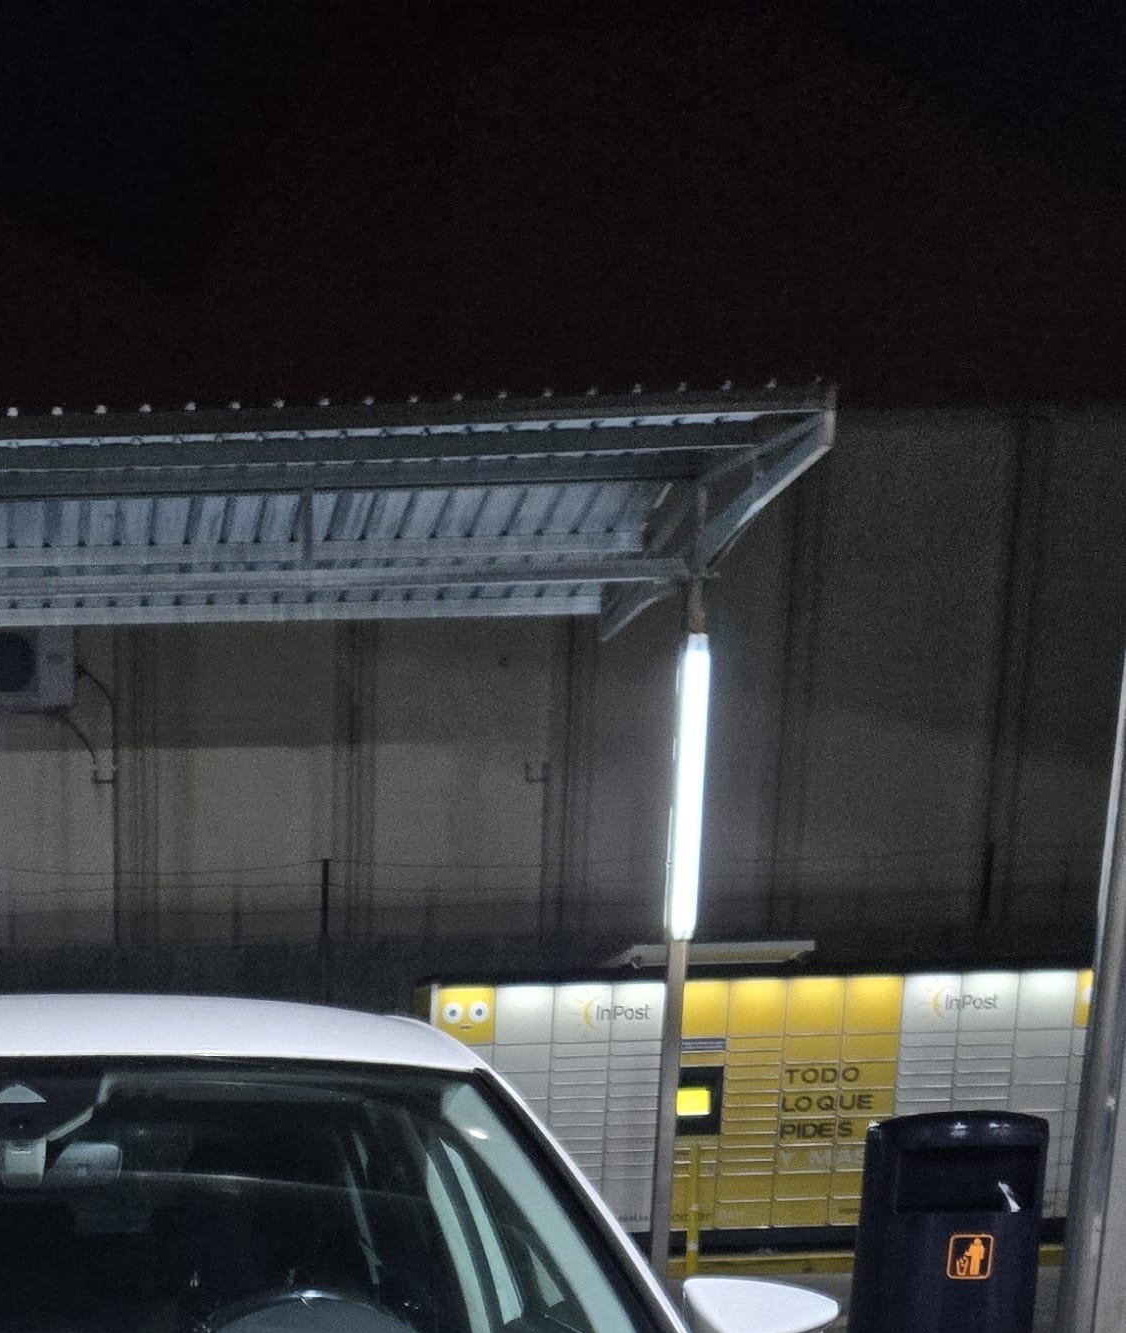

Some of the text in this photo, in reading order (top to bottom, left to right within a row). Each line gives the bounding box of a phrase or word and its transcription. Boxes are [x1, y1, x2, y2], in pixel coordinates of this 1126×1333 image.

[945, 993, 1000, 1010] InPost
[596, 1003, 650, 1020] InPost
[785, 1067, 859, 1084] TODO
[780, 1122, 852, 1138] PIDES
